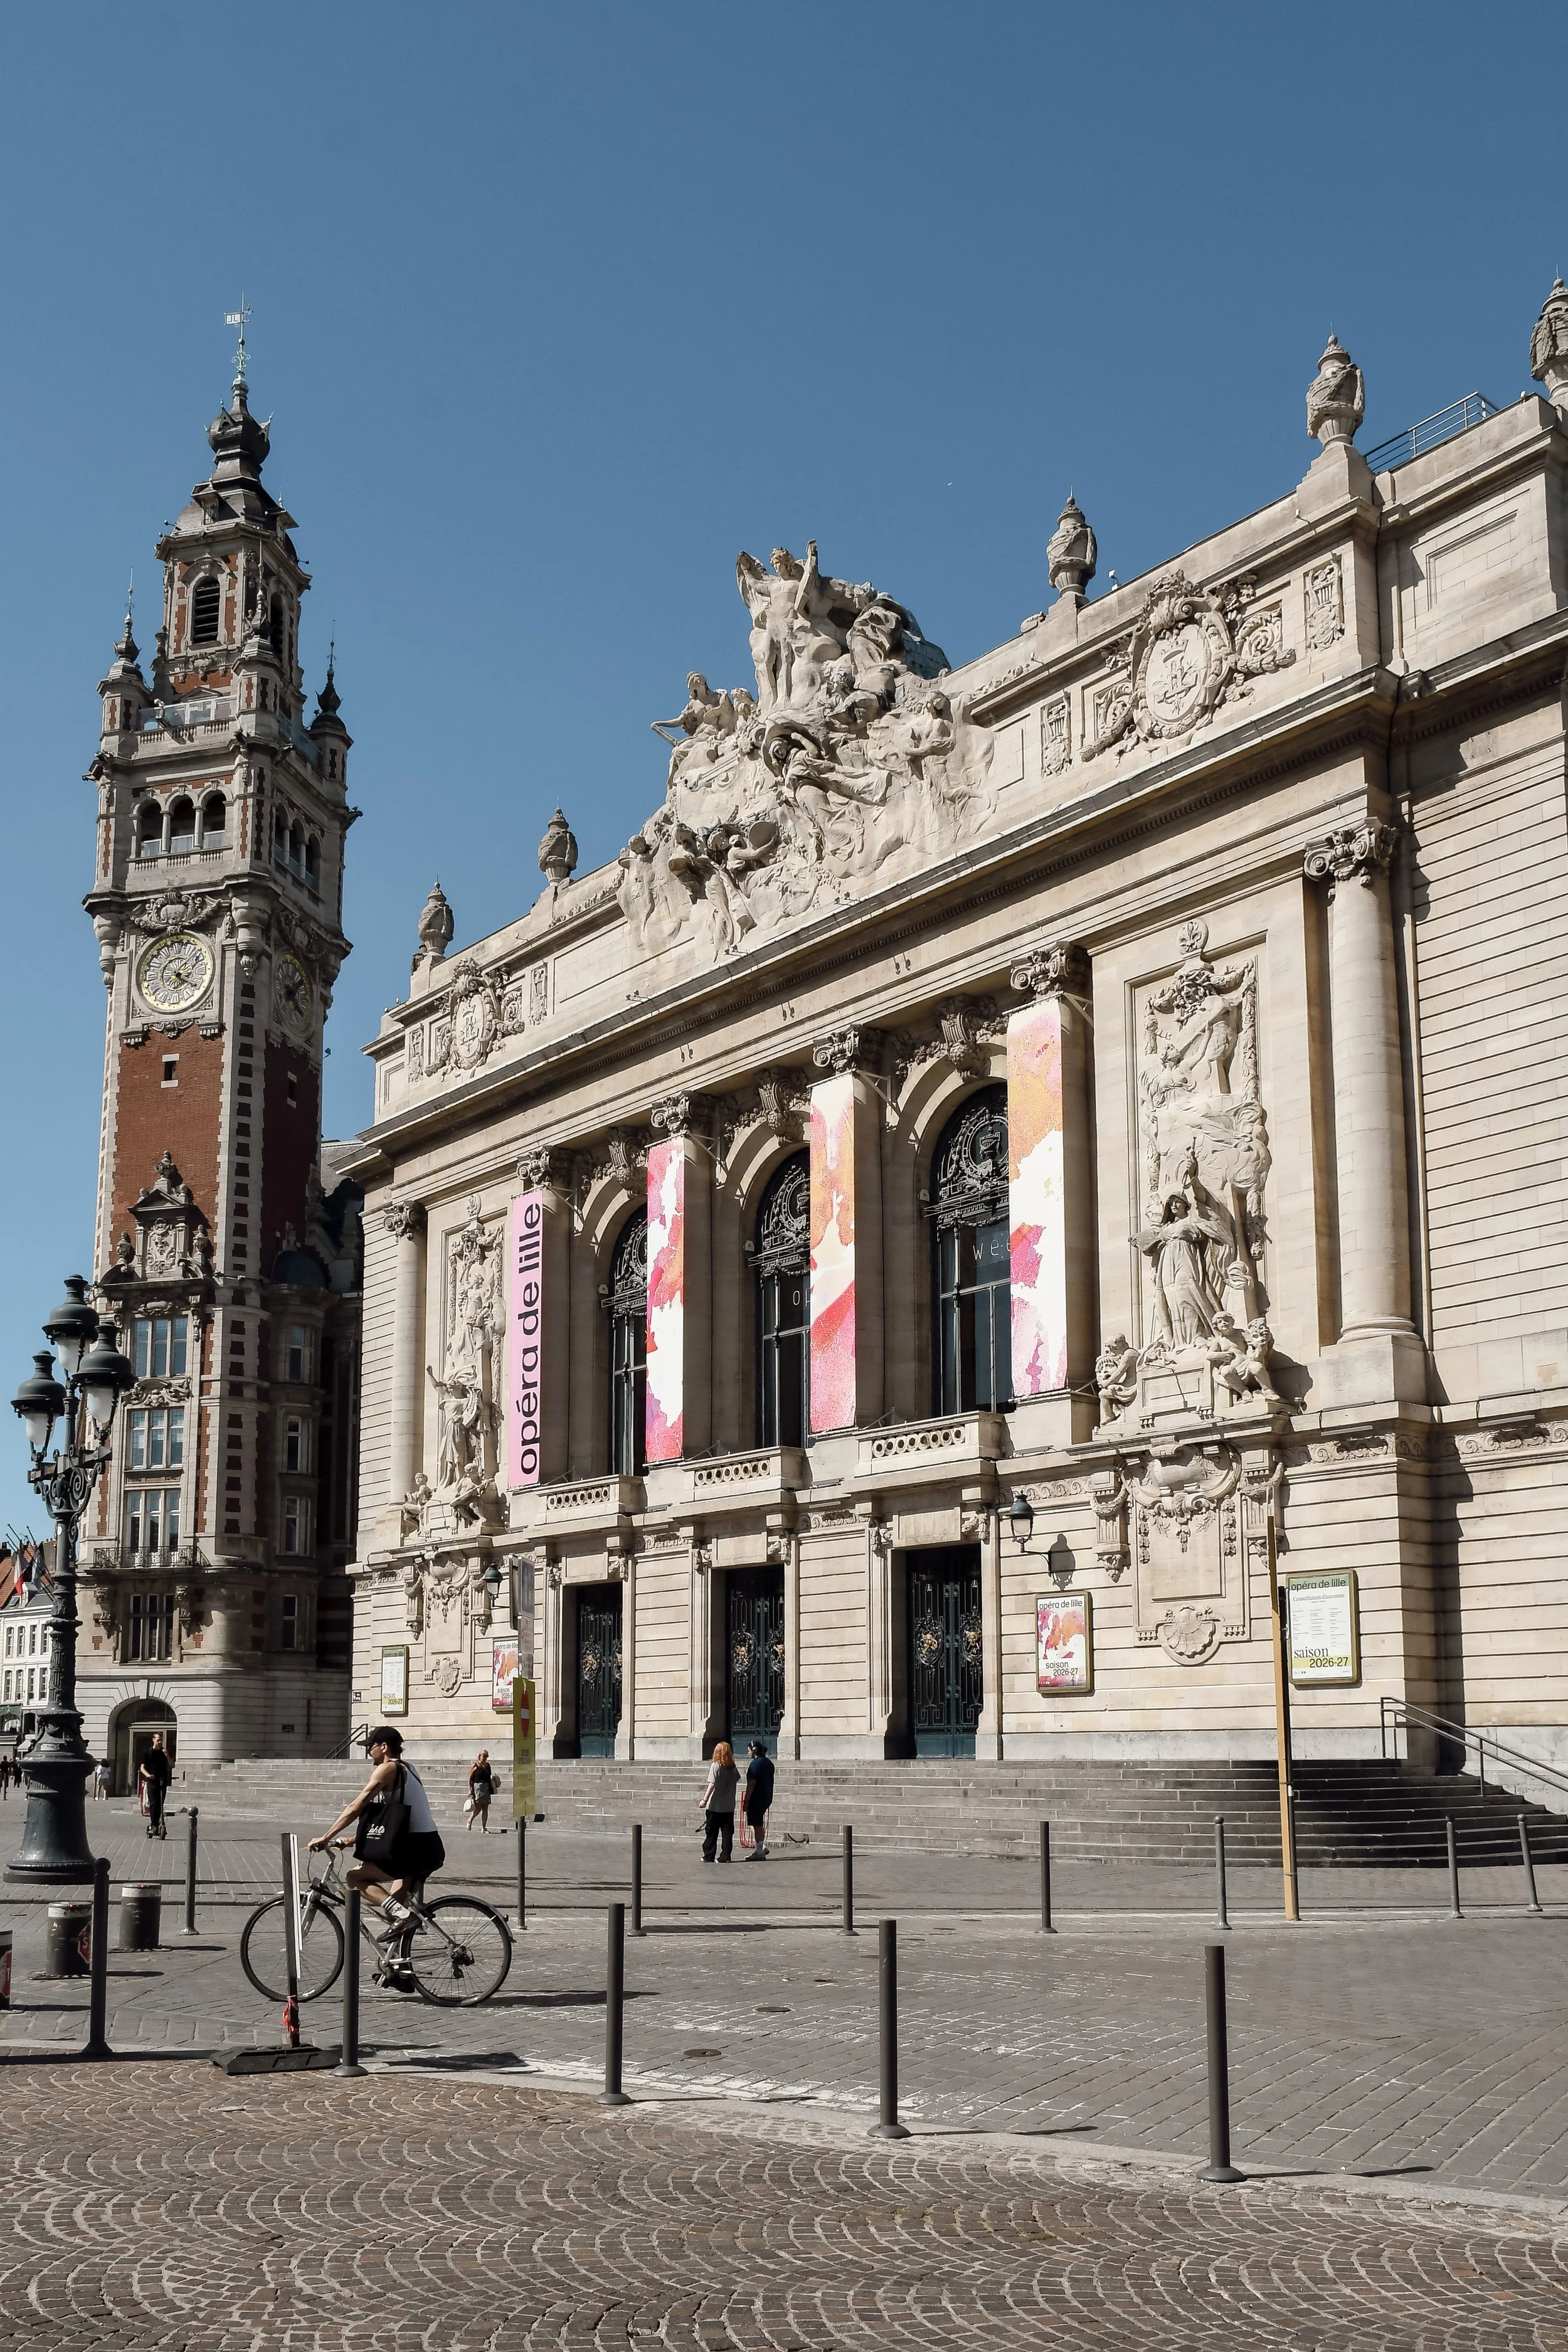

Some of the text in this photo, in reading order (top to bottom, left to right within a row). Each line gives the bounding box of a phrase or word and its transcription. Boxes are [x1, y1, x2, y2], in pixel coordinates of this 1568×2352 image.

[516, 1203, 540, 1475] opéra de lille
[1291, 1578, 1346, 1592] opéra de lille
[1039, 1599, 1083, 1610] opéra de lille
[1294, 1646, 1329, 1658] saison
[1046, 1661, 1069, 1669] saison
[1310, 1656, 1348, 1668] 2026-27
[1053, 1668, 1078, 1677] 2026-27
